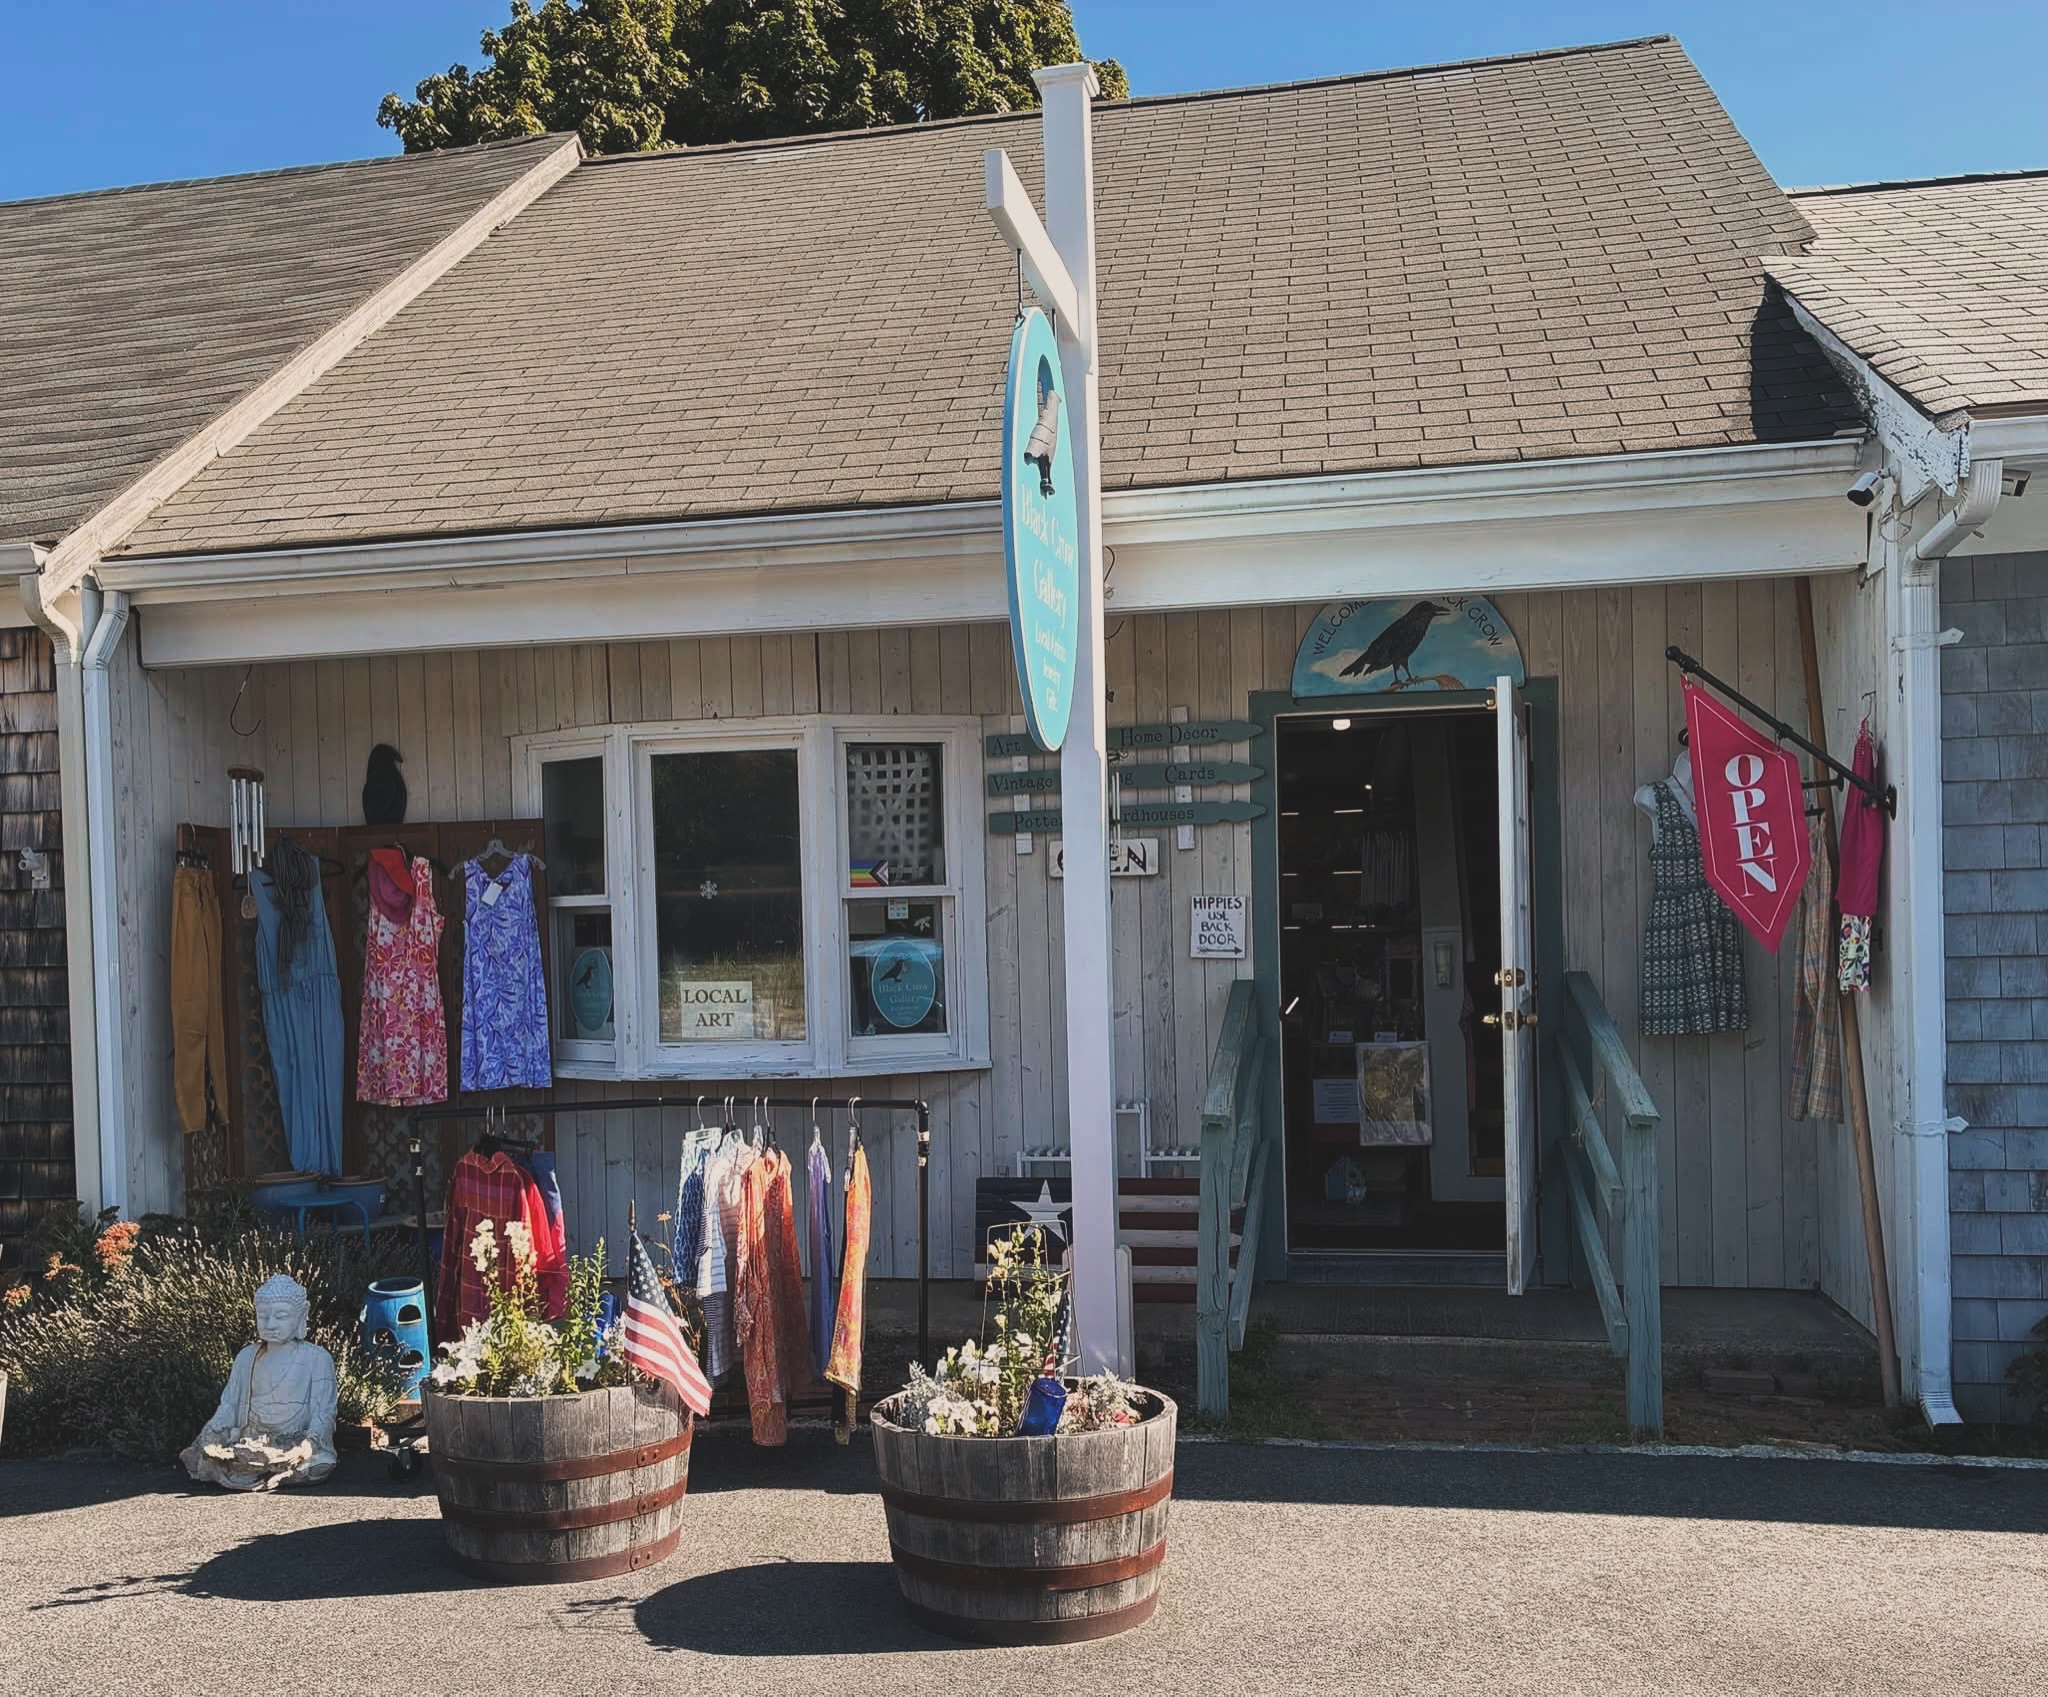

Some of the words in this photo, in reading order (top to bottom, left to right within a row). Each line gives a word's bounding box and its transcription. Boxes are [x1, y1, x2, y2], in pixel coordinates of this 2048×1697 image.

[1468, 607, 1504, 646] CROW
[993, 737, 1022, 755] Art
[1121, 727, 1162, 746] Home
[1168, 725, 1218, 744] Decor
[992, 775, 1053, 792] Vintage
[1164, 765, 1216, 784] Cards
[1014, 814, 1062, 832] Potte
[1123, 808, 1195, 823] rdhouses
[1725, 753, 1778, 897] OPEN
[1193, 896, 1242, 910] HIPPIES
[1201, 921, 1233, 932] BACK
[1199, 933, 1238, 945] DOOR
[683, 989, 748, 1004] LOCAL
[696, 1012, 735, 1027] ART
